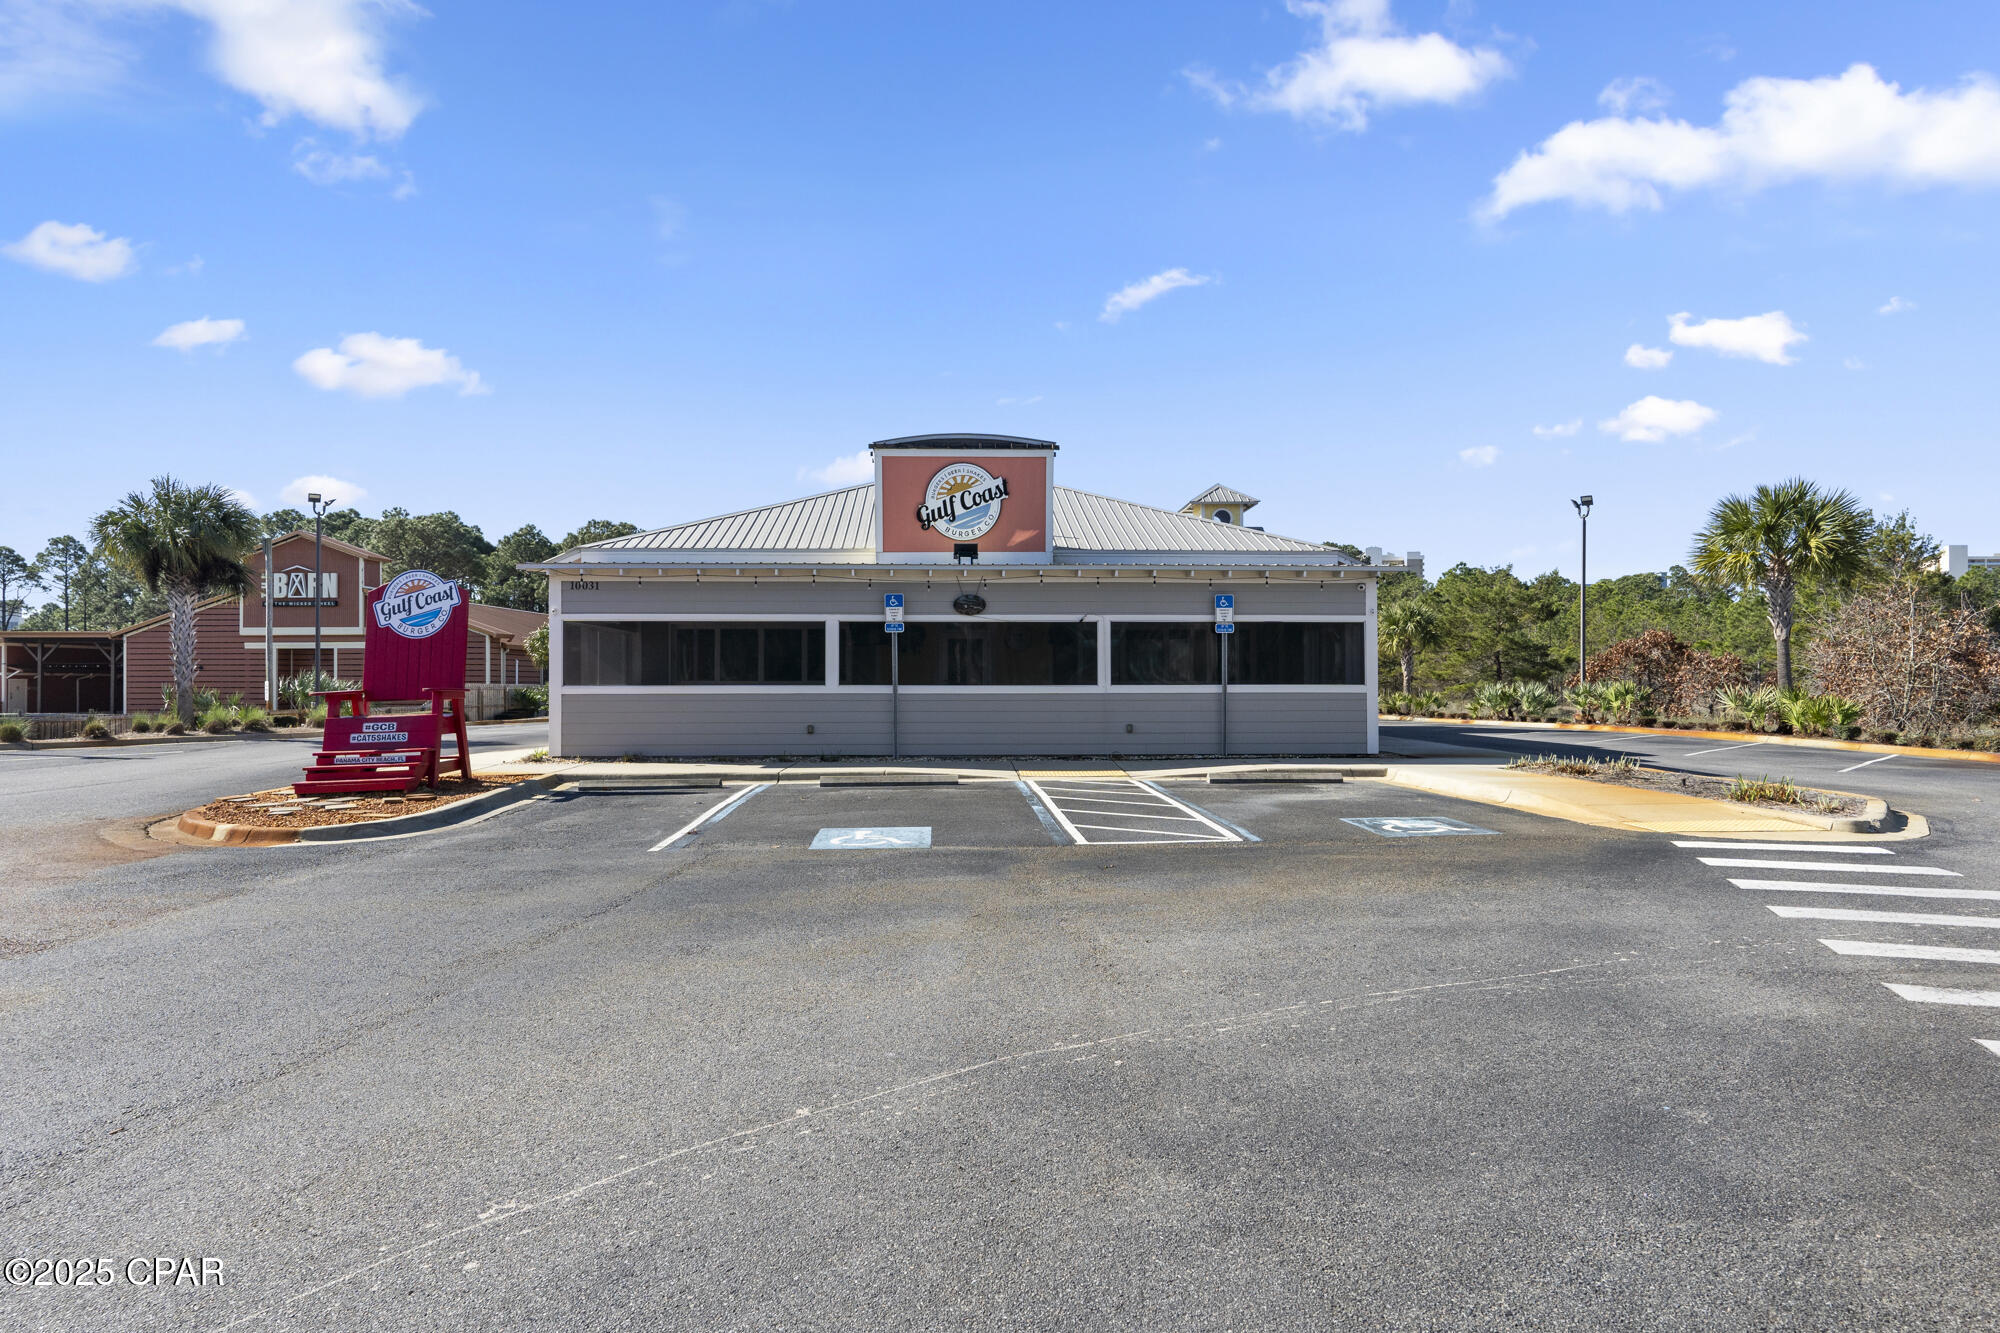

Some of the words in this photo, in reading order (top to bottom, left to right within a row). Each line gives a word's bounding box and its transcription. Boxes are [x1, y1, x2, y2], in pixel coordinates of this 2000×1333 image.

[947, 468, 961, 476] BEER
[966, 468, 987, 482] SHAKES
[917, 495, 956, 530] Gulf
[960, 479, 1009, 510] Coast
[945, 526, 983, 537] BURGER
[571, 581, 599, 590] 10031
[381, 595, 413, 621] Gulf
[415, 585, 454, 609] Coast
[397, 622, 437, 635] BURGER
[365, 723, 395, 731] #GCB
[351, 733, 407, 742] #CAT5SHAKES
